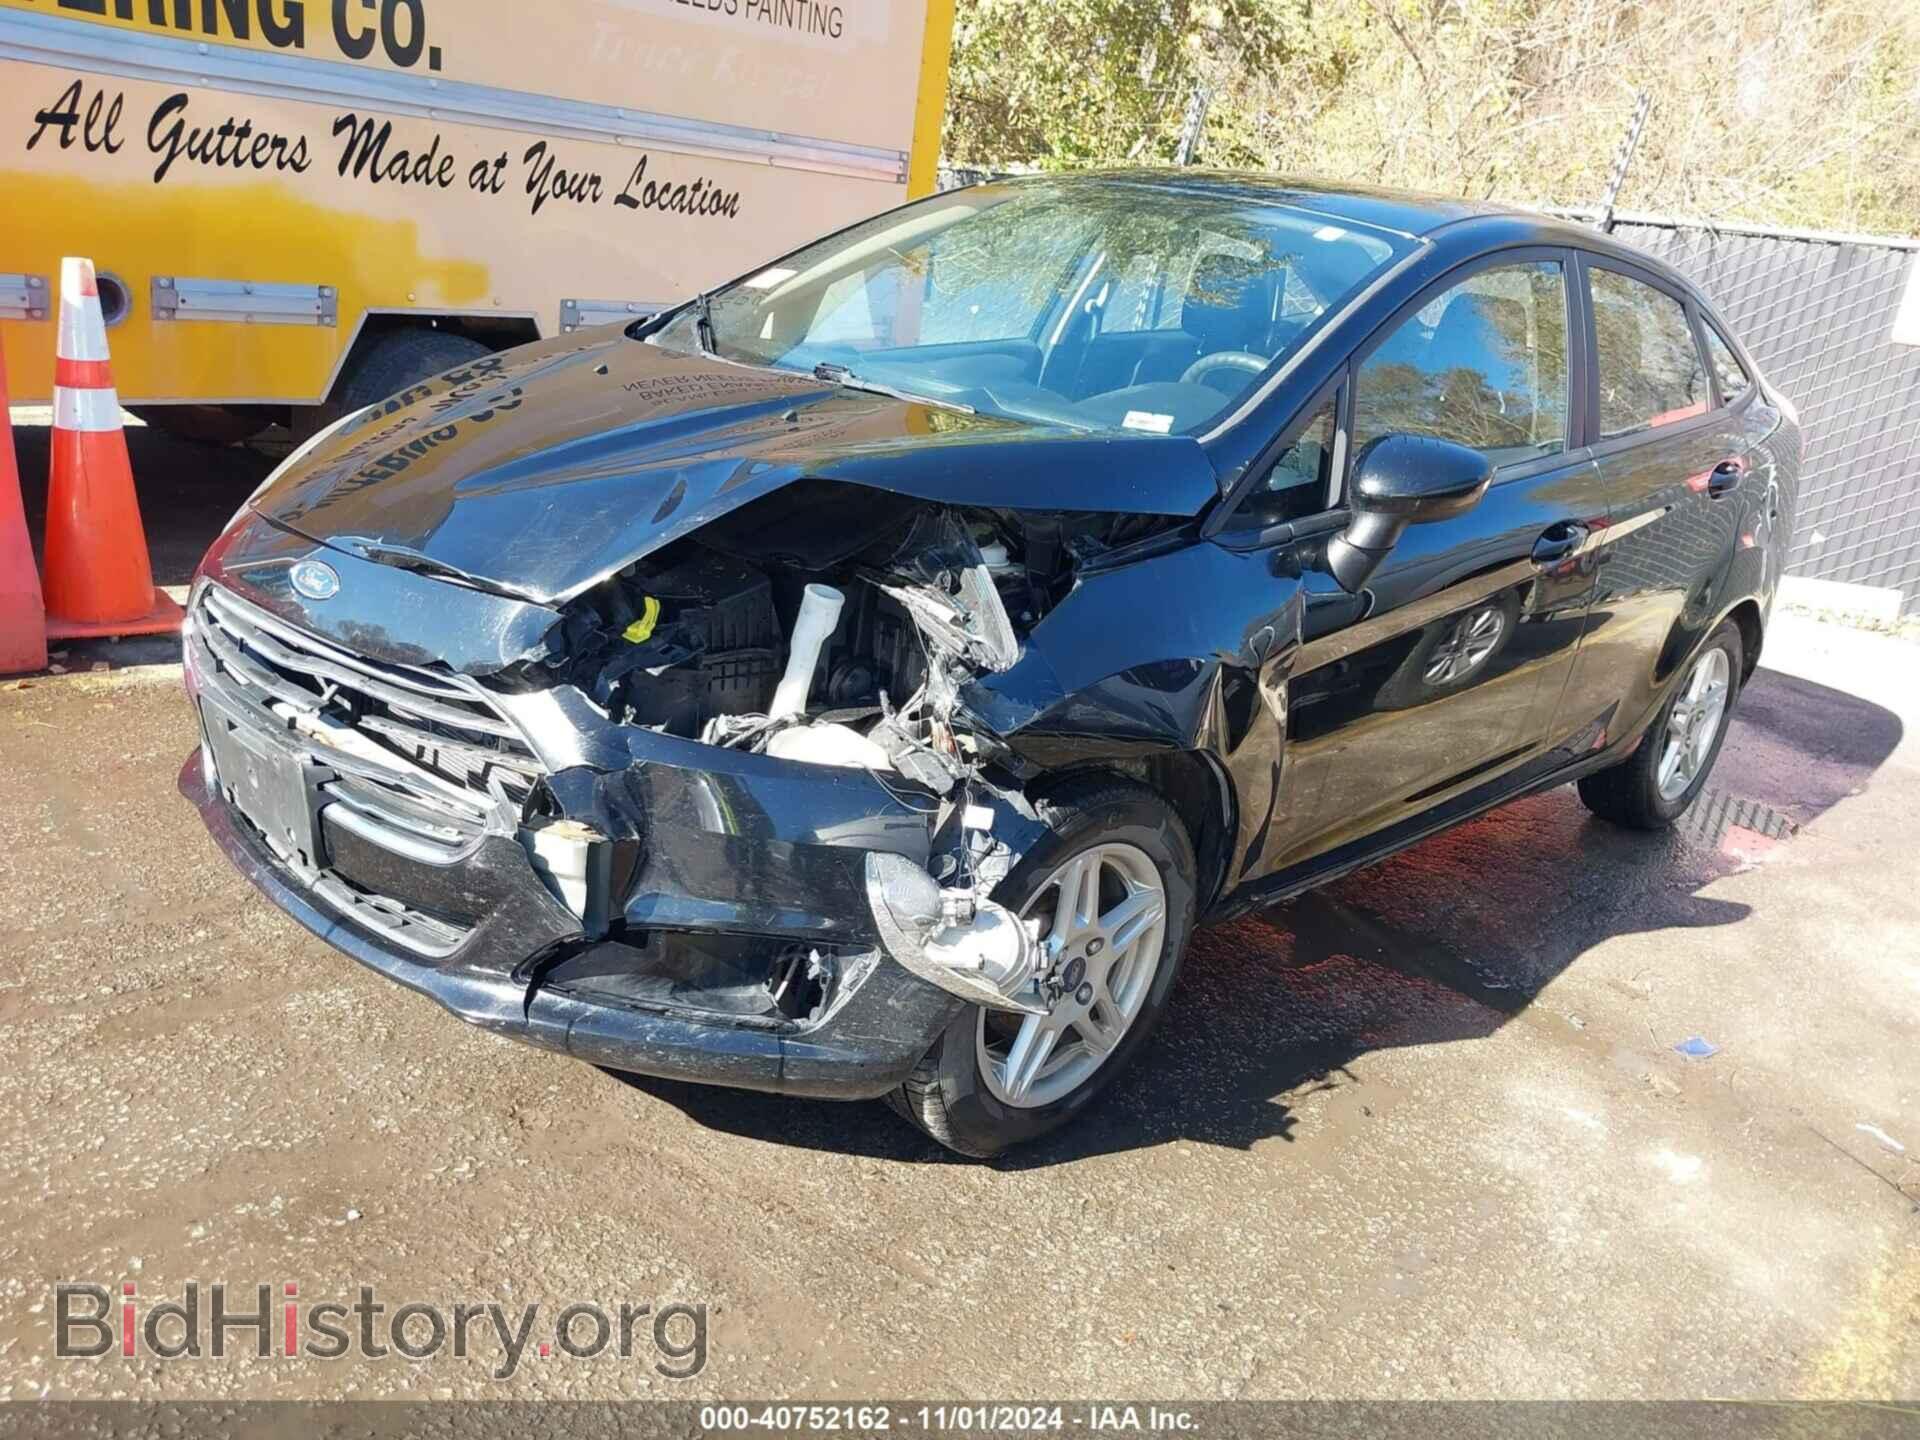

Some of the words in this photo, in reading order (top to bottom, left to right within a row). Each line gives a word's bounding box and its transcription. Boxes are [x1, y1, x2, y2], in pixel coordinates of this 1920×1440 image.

[332, 0, 442, 71] CO.
[745, 0, 843, 38] PAINTING
[26, 79, 125, 154] All
[147, 93, 312, 183] Gutters
[332, 113, 455, 188] Made
[469, 151, 507, 194] at
[523, 141, 603, 215] Your
[613, 154, 740, 218] Location
